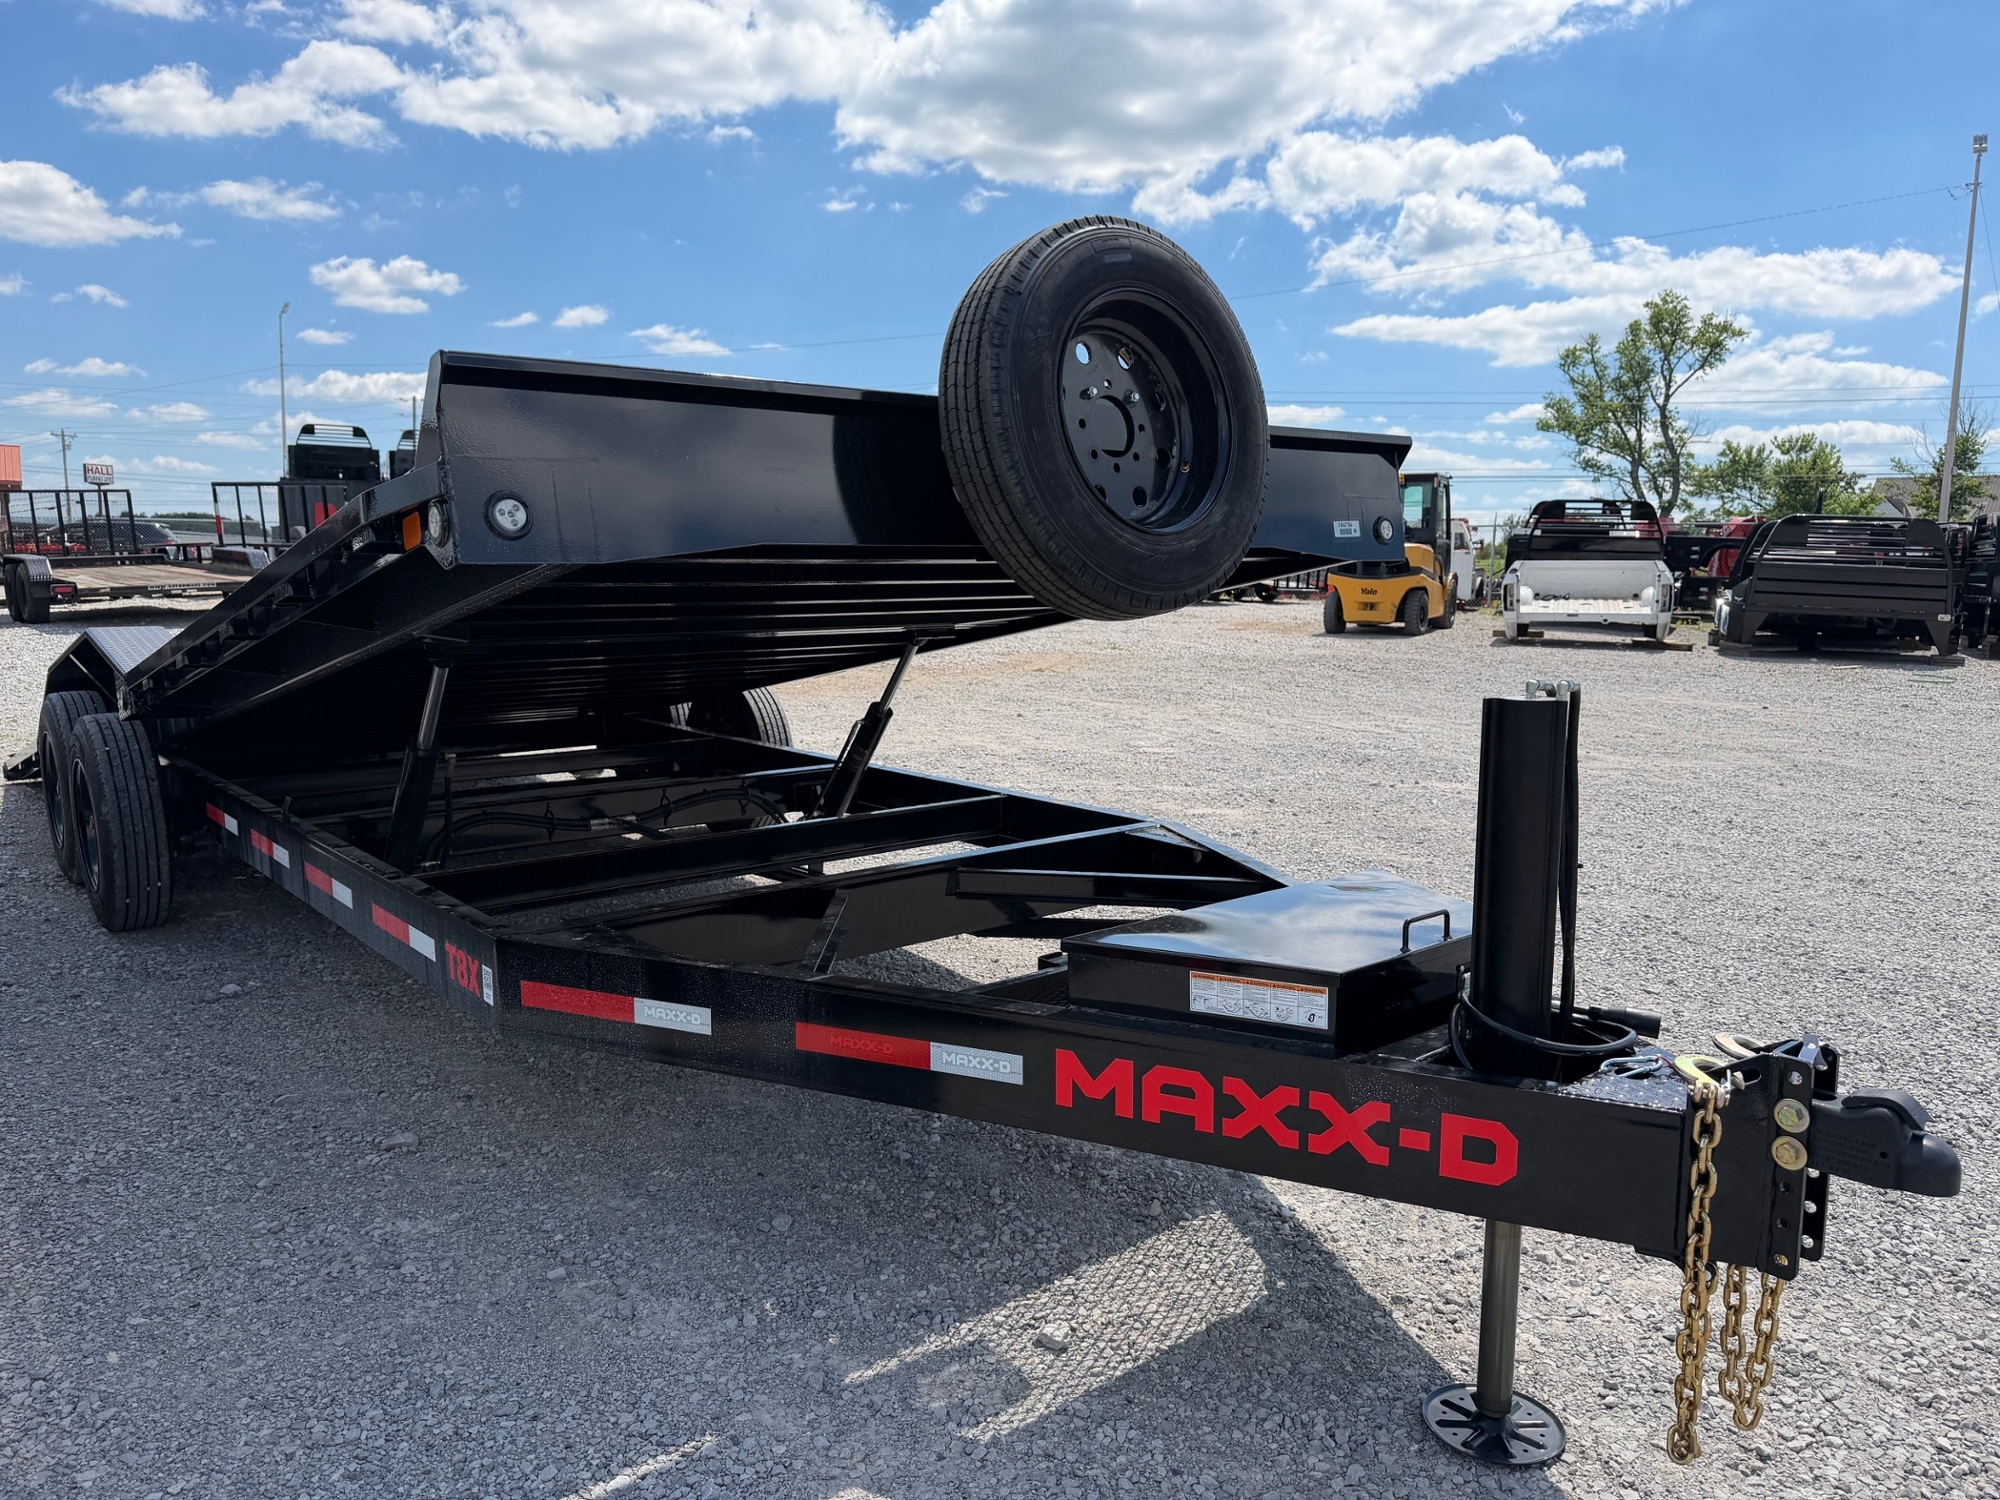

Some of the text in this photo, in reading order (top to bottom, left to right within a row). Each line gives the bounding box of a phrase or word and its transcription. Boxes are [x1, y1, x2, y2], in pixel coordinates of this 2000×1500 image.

[86, 465, 112, 476] HALL
[1360, 587, 1378, 595] Yale
[445, 941, 481, 998] T8X
[643, 1005, 701, 1025] MAXX-D
[829, 1034, 895, 1055] MAXX-D
[942, 1052, 1011, 1074] MAXX-D
[1055, 1048, 1519, 1187] MAXX-D
